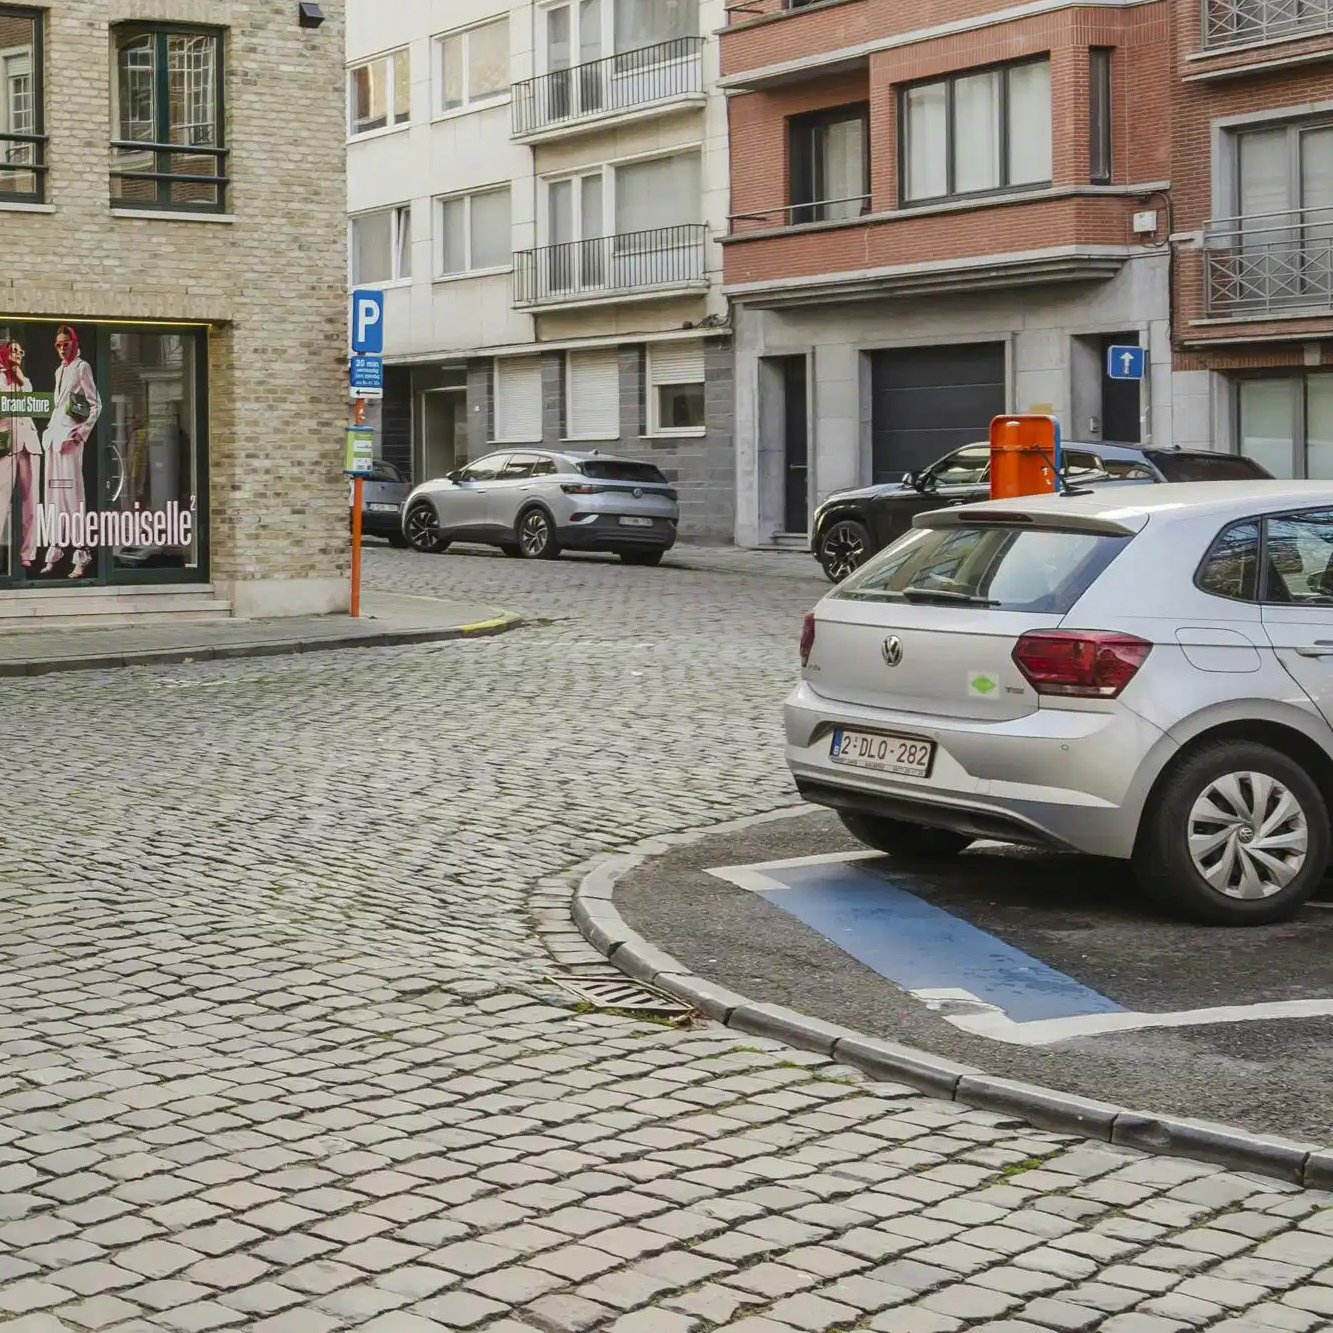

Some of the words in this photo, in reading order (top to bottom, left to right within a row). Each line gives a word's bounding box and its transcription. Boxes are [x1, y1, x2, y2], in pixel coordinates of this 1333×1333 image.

[357, 299, 380, 342] P
[1, 395, 26, 413] Brand
[27, 396, 50, 413] Store
[36, 501, 192, 548] Modemoiselle
